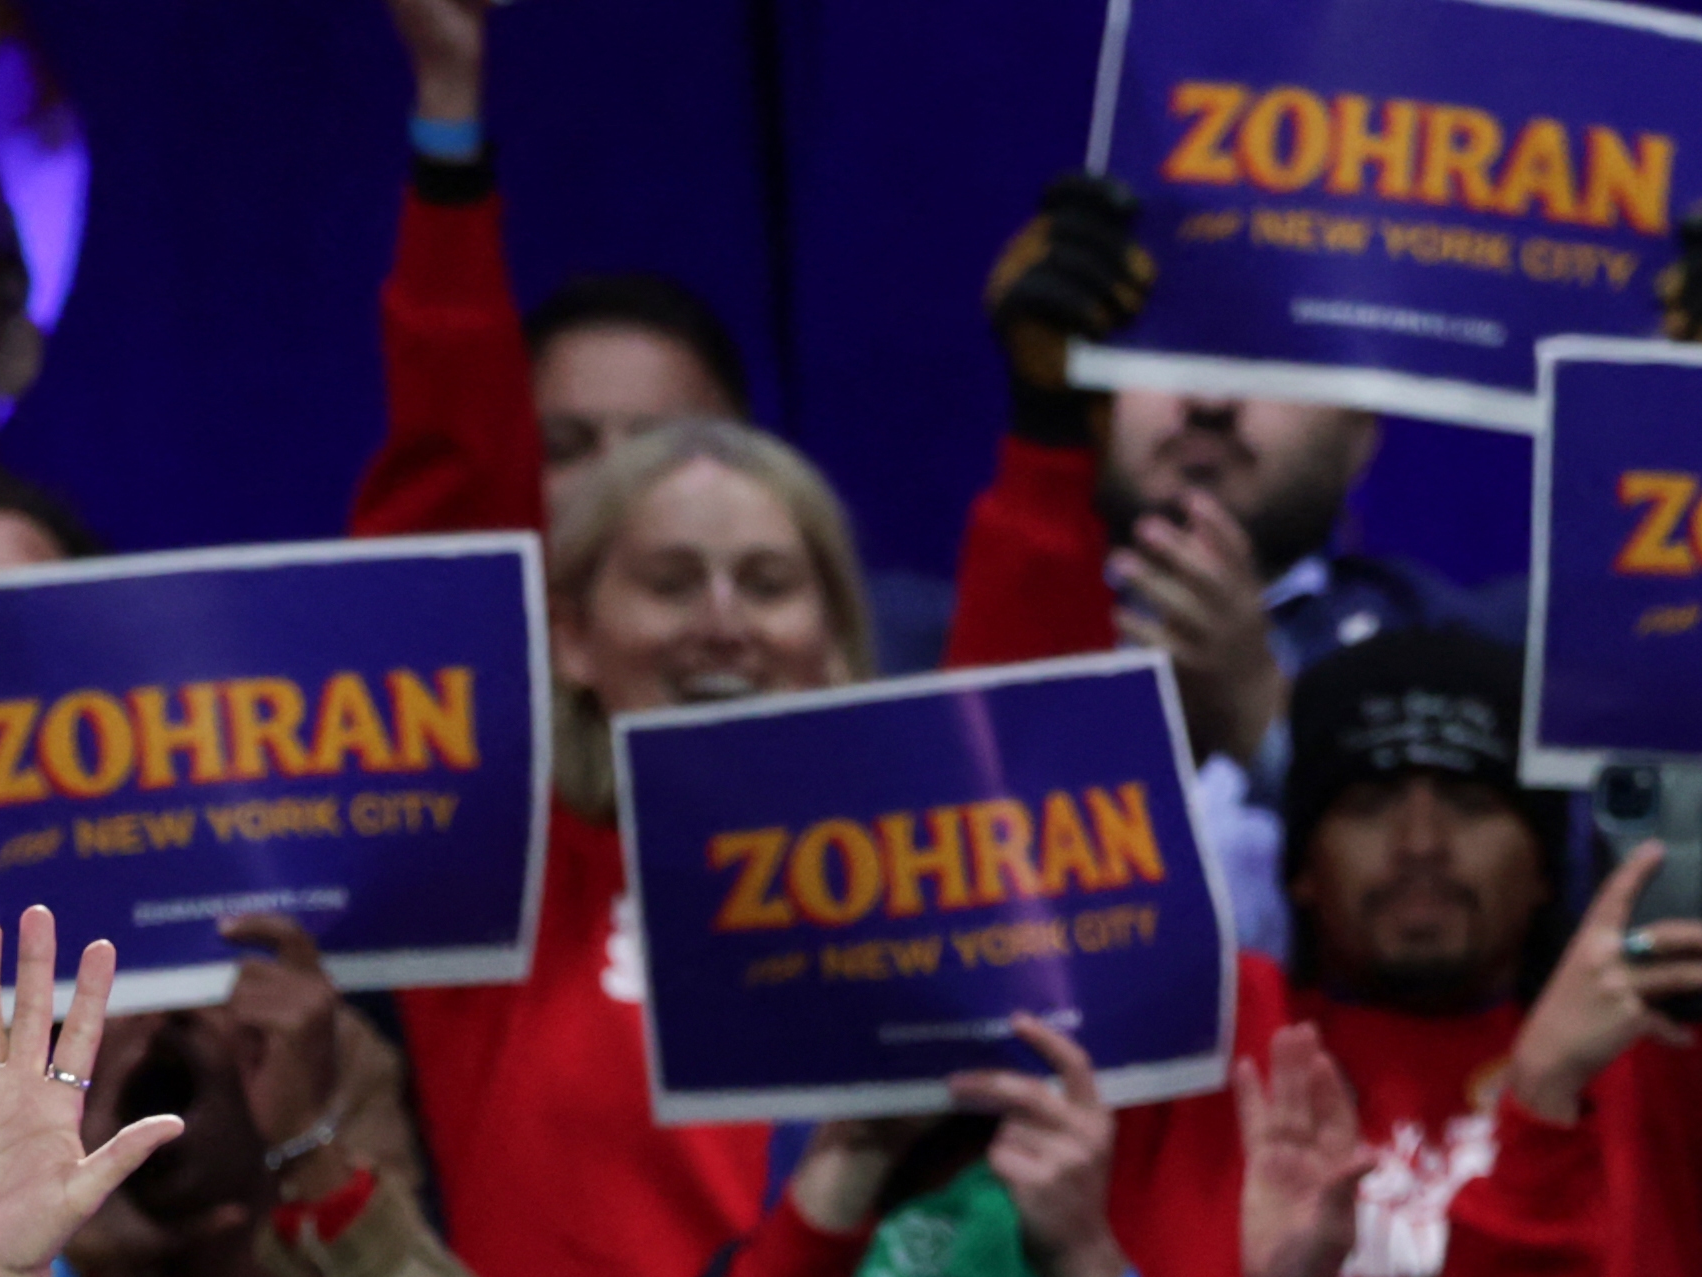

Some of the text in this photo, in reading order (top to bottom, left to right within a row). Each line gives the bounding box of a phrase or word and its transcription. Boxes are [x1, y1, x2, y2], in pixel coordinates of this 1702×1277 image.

[1160, 78, 1678, 238] ZOHRAN
[1249, 205, 1371, 257] NEW
[1381, 216, 1516, 276] YORK
[1518, 235, 1638, 293] CITY
[72, 807, 197, 860] NEW
[202, 792, 342, 846] YORK
[347, 788, 462, 838] CITY
[705, 777, 1167, 936] ZOHRAN
[817, 932, 945, 983] NEW
